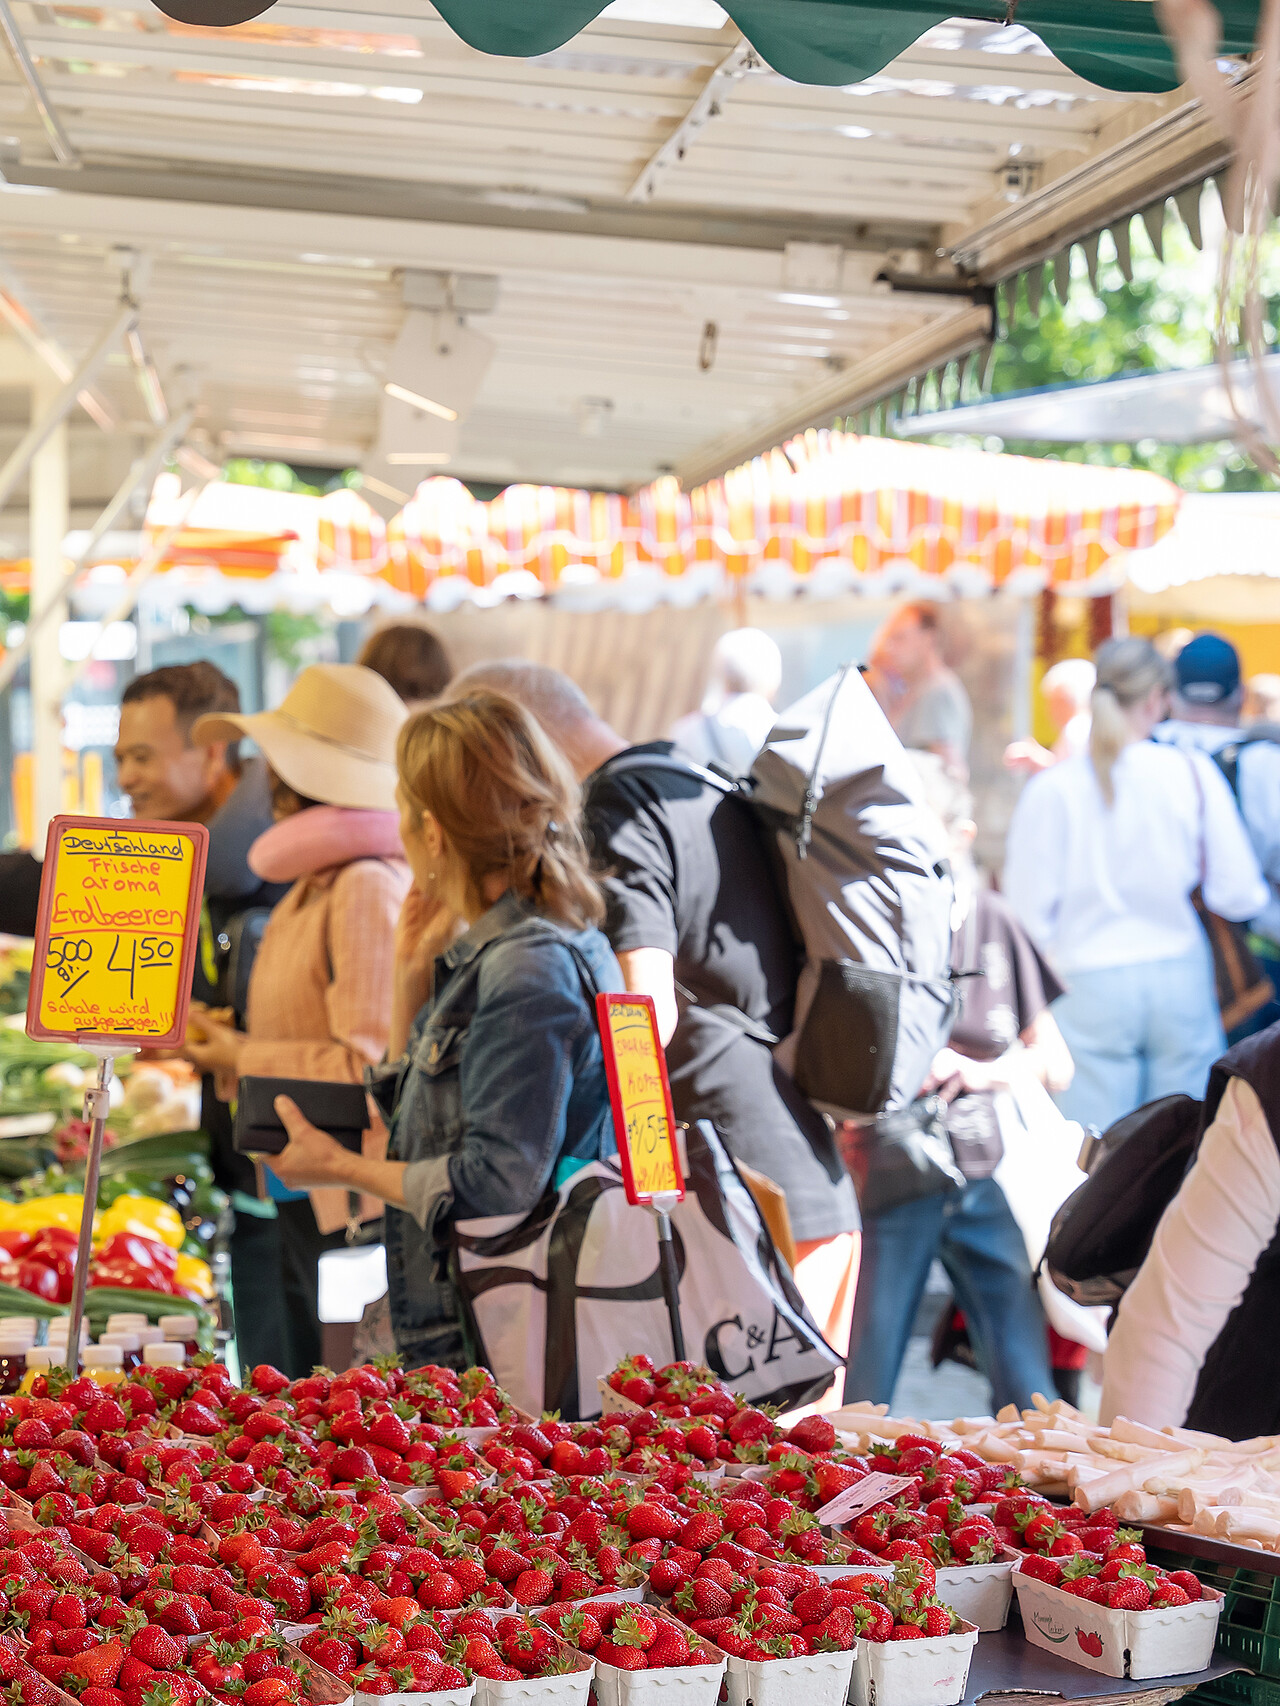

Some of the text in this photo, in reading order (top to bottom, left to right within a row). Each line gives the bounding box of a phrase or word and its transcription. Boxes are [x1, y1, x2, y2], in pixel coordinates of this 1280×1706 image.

[63, 836, 184, 857] Deutschland
[88, 857, 161, 876] Frische
[81, 876, 161, 896] aroma
[52, 892, 184, 927] Erdbeeren
[46, 936, 92, 968] 500
[109, 997, 150, 1014] wird
[705, 1300, 816, 1381] C&A
